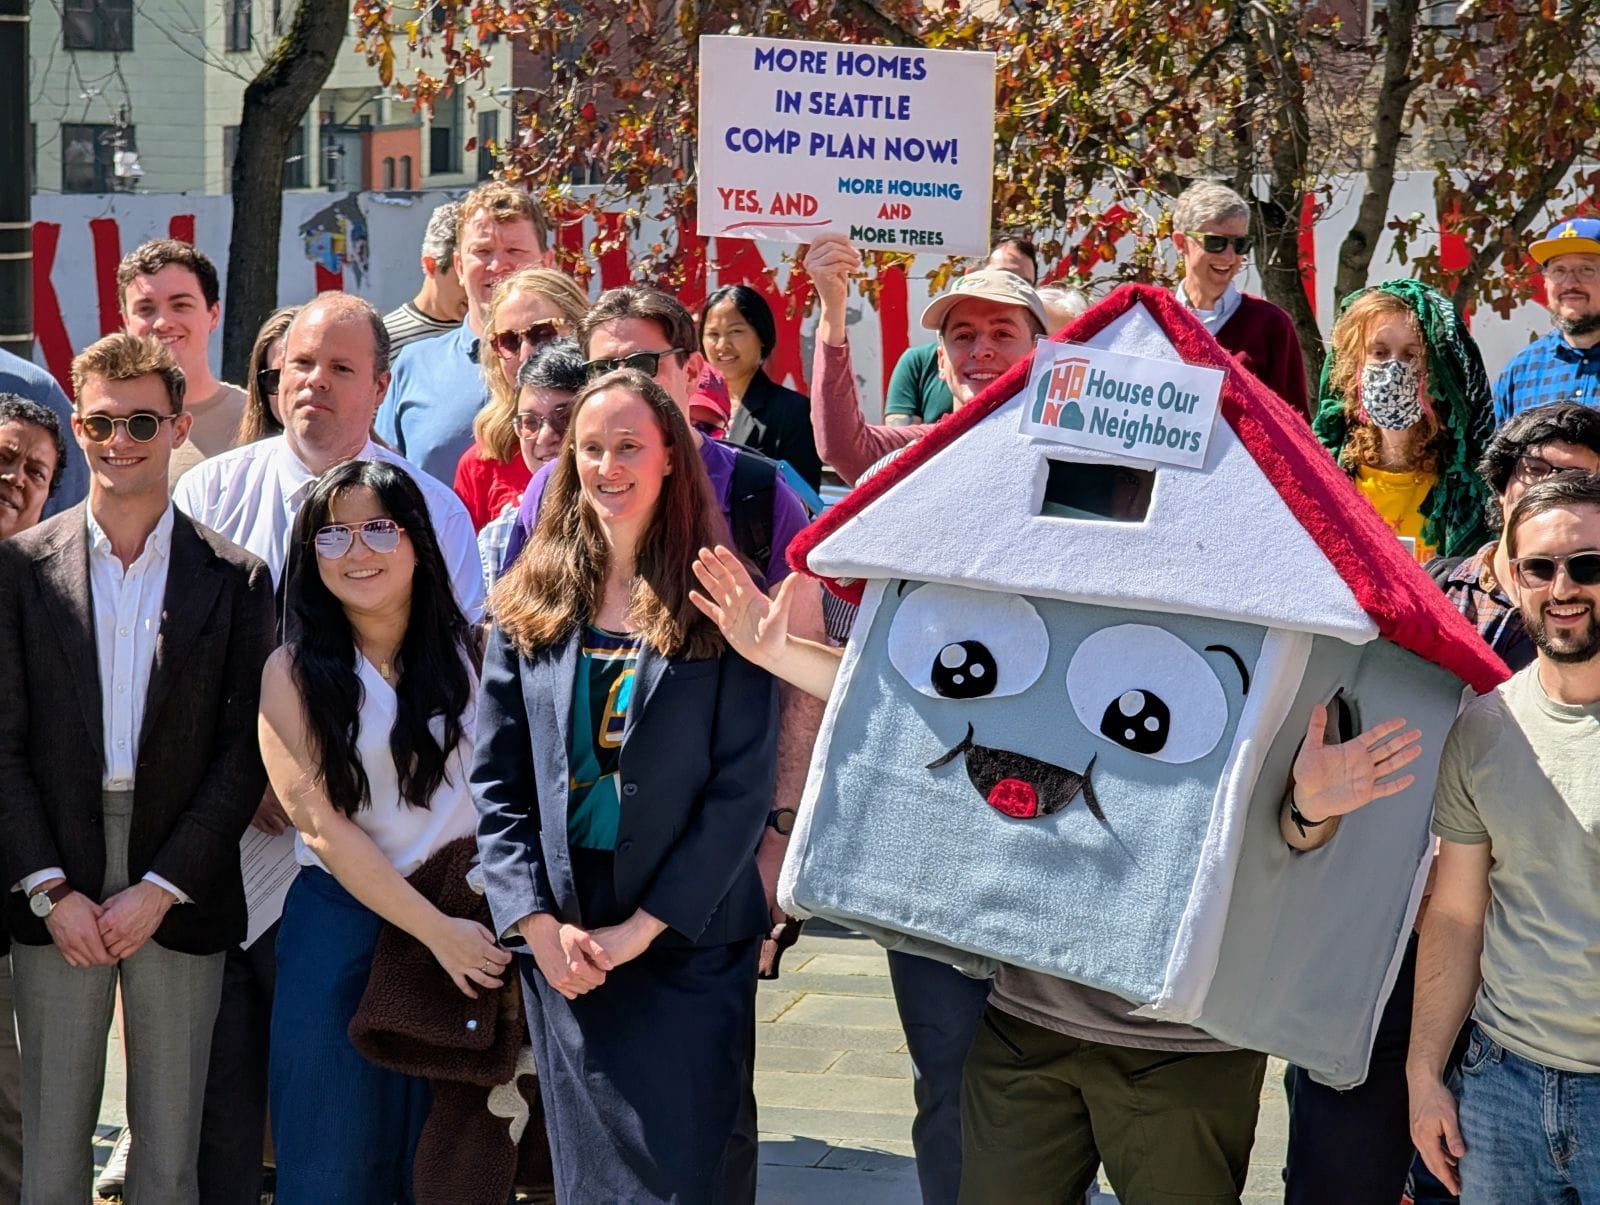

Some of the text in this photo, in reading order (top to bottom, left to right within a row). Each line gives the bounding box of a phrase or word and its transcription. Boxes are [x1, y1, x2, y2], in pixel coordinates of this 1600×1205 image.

[754, 46, 927, 81] MORE HOMES
[775, 89, 911, 121] IN SEATTLE
[725, 126, 958, 165] COMP PLAN NOW!
[717, 187, 818, 217] YES, AND
[838, 176, 963, 201] MORE HOUSING
[877, 202, 912, 221] AND
[850, 224, 944, 246] MORE TREES
[1086, 368, 1200, 415] House Our
[1089, 406, 1202, 453] Neighbors
